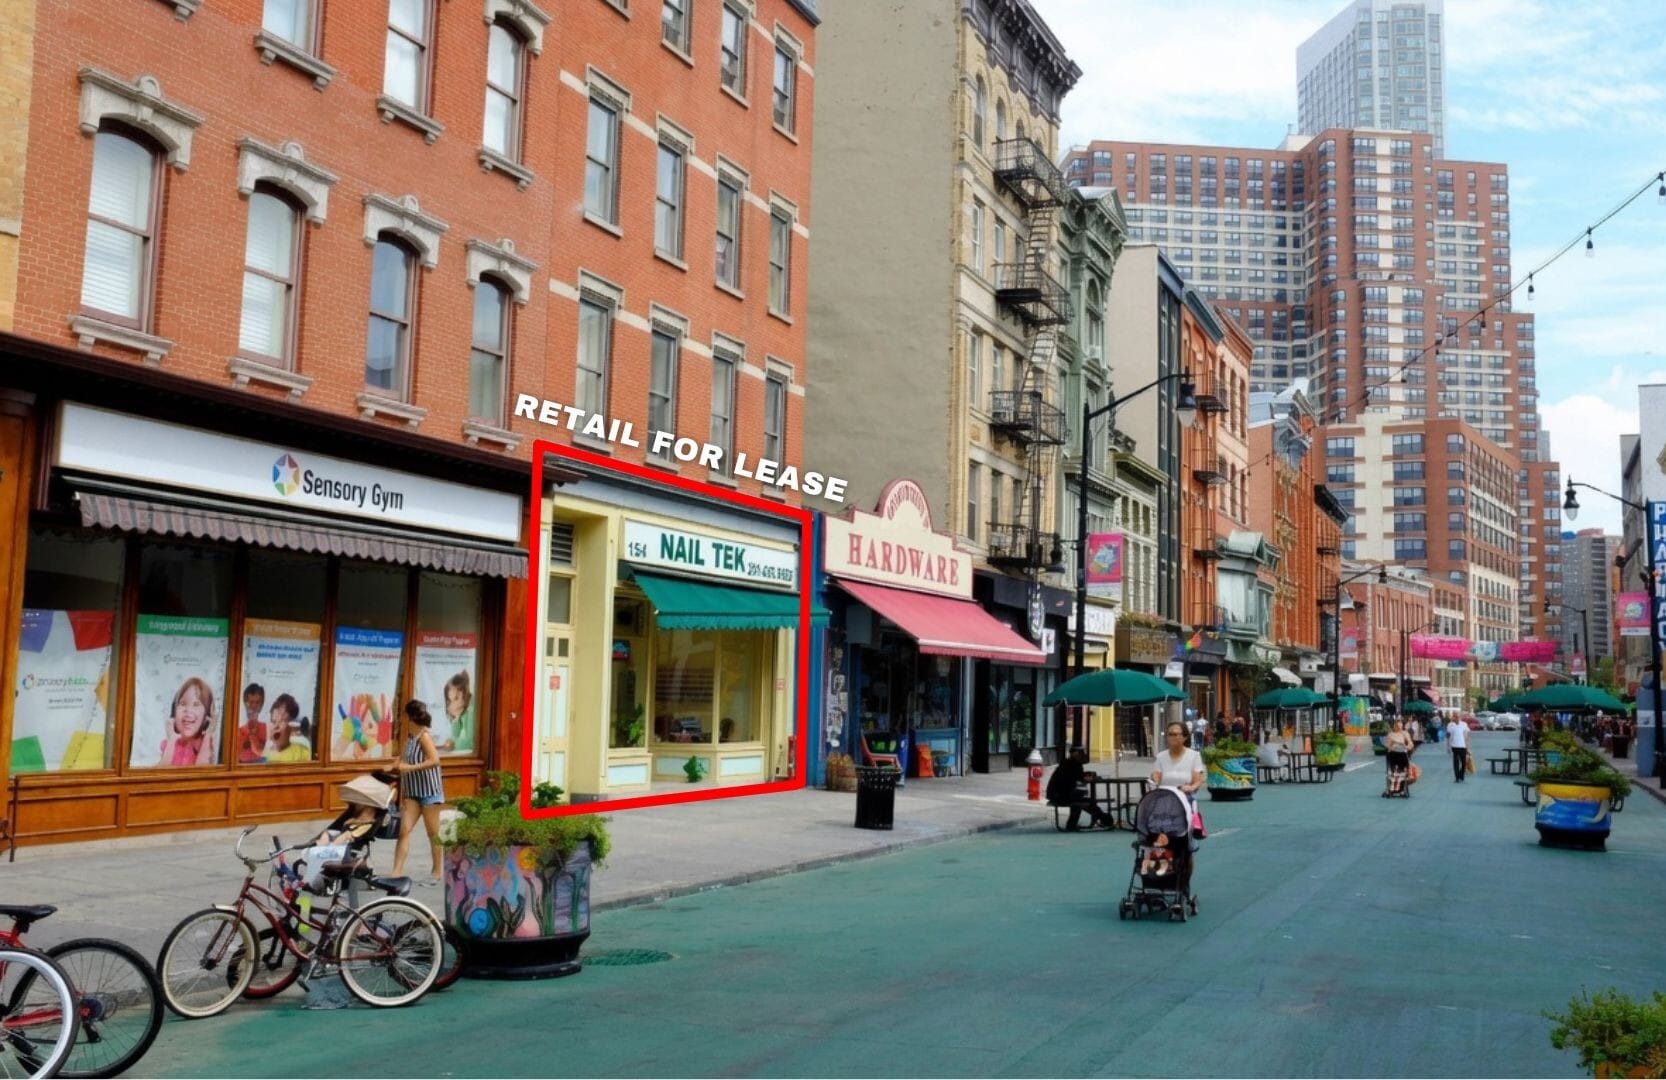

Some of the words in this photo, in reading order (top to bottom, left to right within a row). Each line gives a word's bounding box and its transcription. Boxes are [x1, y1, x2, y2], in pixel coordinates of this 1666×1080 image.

[303, 469, 367, 508] Sensory
[372, 483, 403, 512] Gym
[628, 541, 647, 558] 154
[661, 533, 705, 566] NAIL
[712, 542, 746, 572] TEK
[847, 532, 959, 587] HARDWARE
